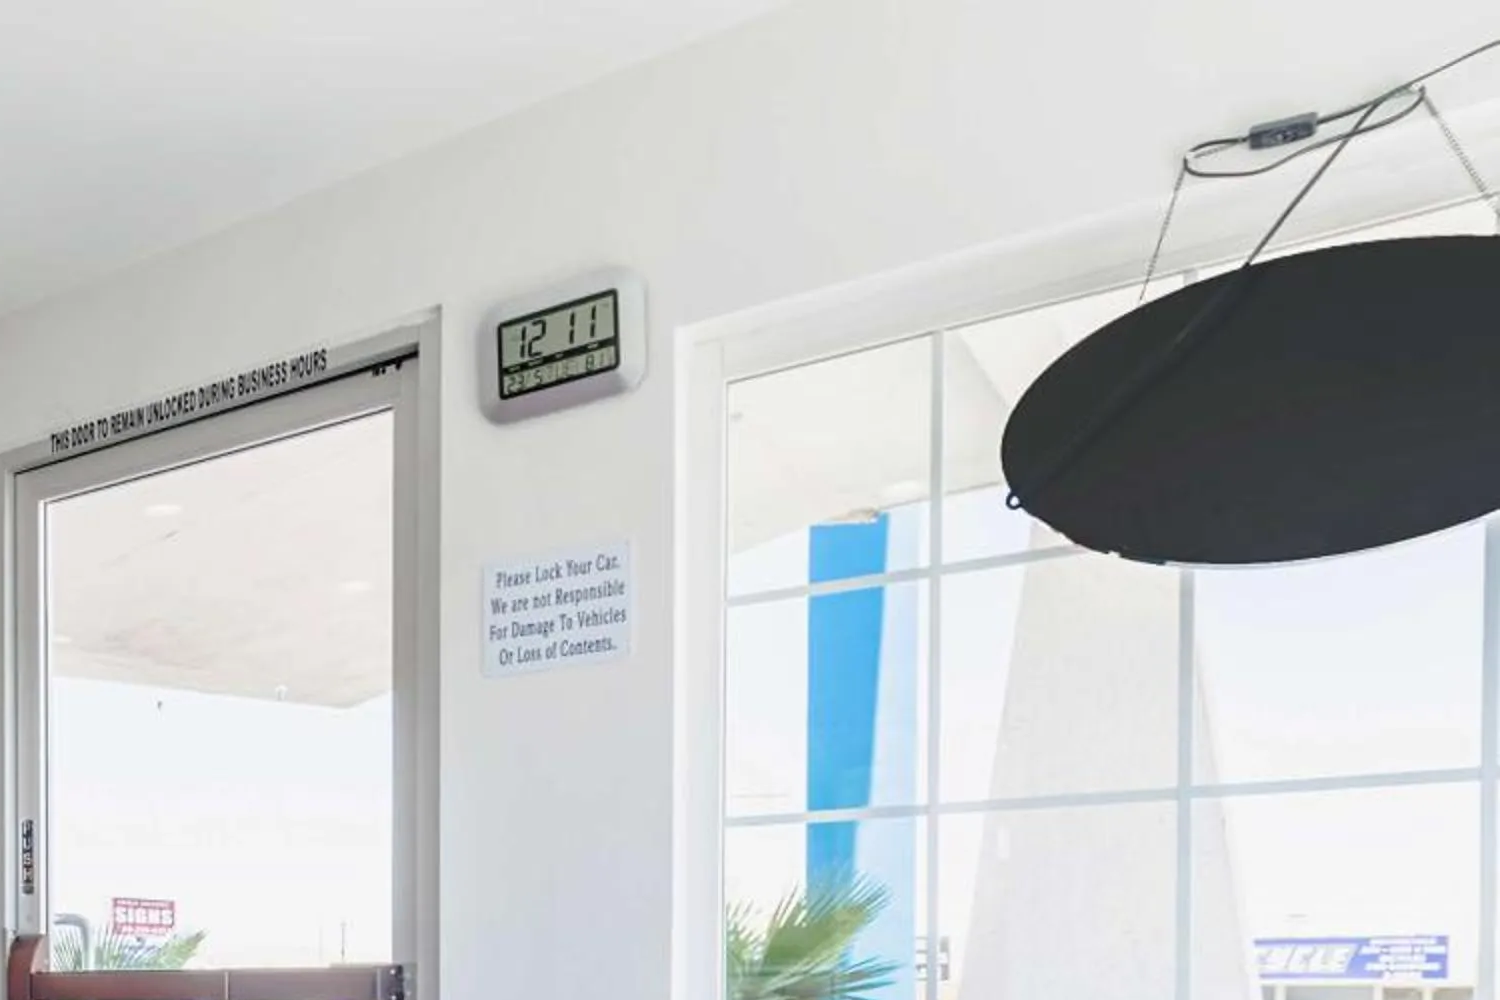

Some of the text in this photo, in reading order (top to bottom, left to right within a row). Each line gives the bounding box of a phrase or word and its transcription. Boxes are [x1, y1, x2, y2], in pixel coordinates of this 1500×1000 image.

[50, 348, 327, 453] THIS DOOR TO REMAIN UNLOCKED DURING BUSINESS HOURS
[496, 571, 531, 589] Please
[535, 562, 563, 582] Lock
[565, 559, 592, 577] Your
[490, 579, 625, 615] We are not Responsible
[489, 607, 627, 641] For Damage To Vehicles
[499, 648, 514, 666] Or
[517, 645, 542, 664] Loss
[545, 641, 558, 659] of
[115, 906, 173, 926] SIGNS
